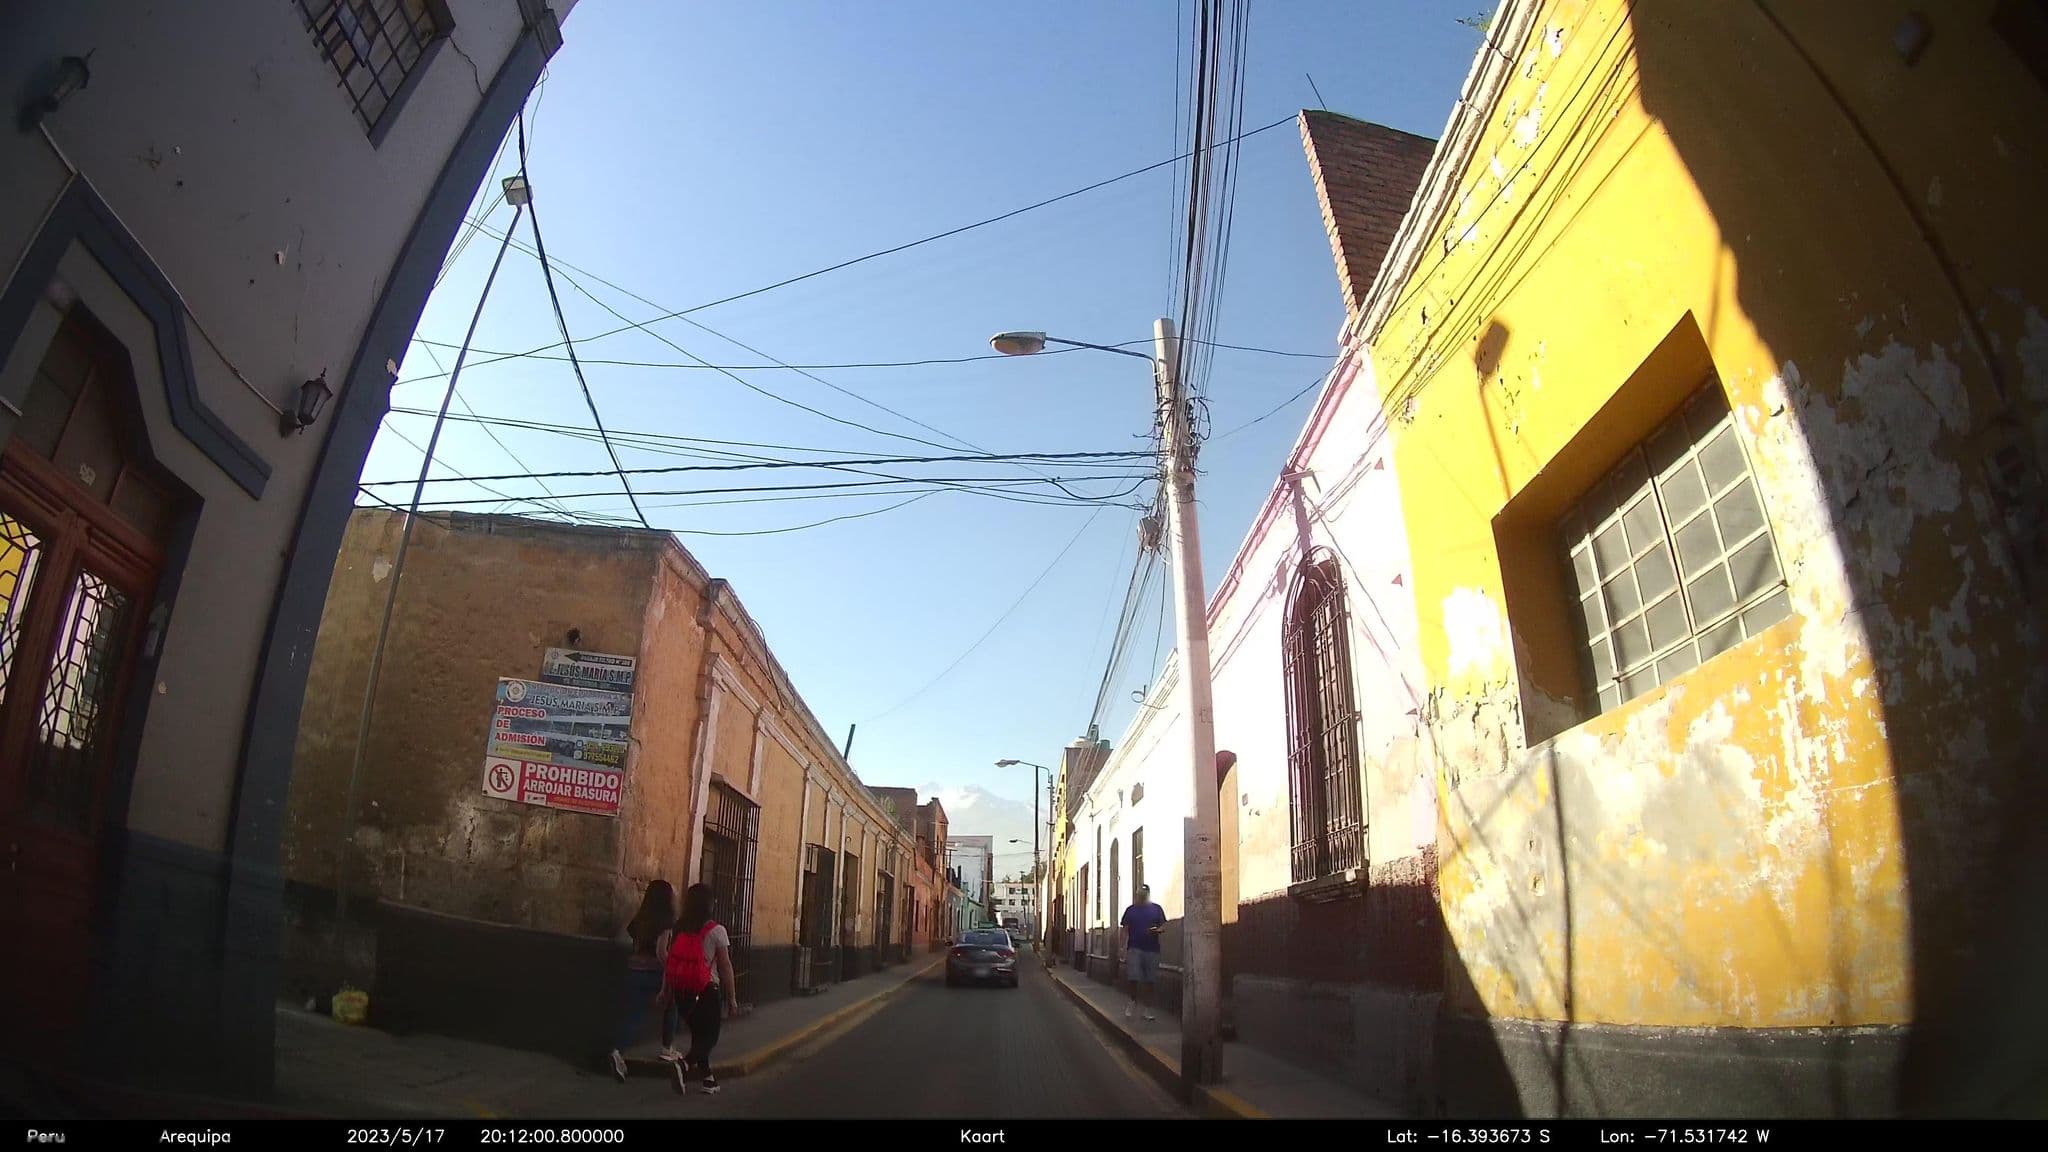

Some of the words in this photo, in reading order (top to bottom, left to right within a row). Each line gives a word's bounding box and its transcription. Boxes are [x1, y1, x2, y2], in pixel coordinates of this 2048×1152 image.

[497, 706, 546, 719] PROCESO
[496, 719, 511, 729] DE
[525, 762, 619, 790] PROHIBIDO
[523, 779, 571, 797] ARROJAR
[574, 786, 618, 803] BASURA
